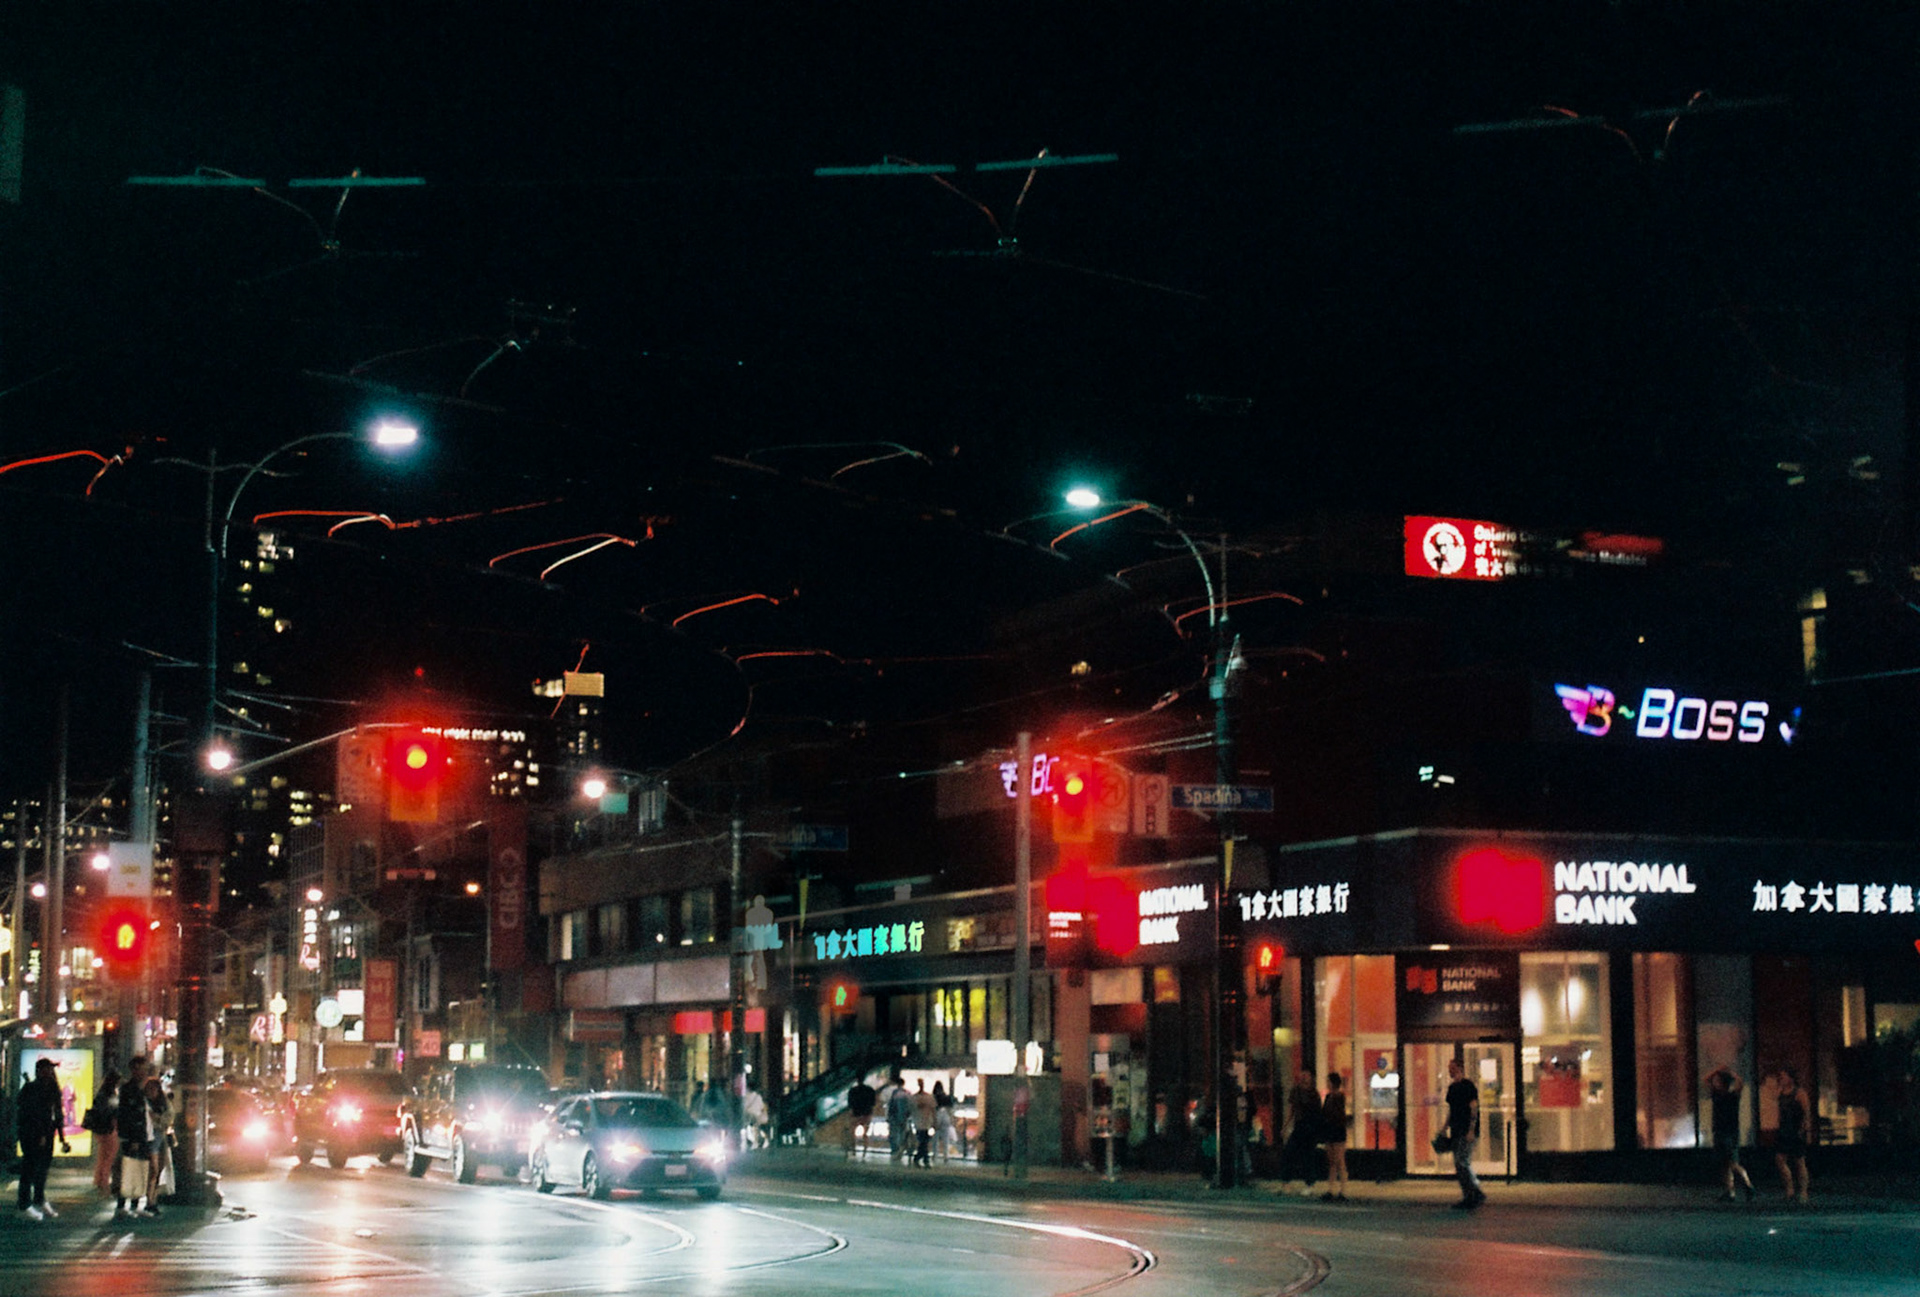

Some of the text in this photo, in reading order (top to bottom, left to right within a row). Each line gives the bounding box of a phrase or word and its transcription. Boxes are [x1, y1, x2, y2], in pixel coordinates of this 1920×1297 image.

[1183, 784, 1242, 808] Spadina
[1554, 861, 1697, 893] NATIONAL
[1139, 884, 1208, 916] NATIONAL
[1555, 894, 1638, 924] BANK
[1752, 879, 1920, 914] 加拿大國家銀
[1139, 916, 1180, 945] BANK
[1442, 967, 1501, 979] NATIONAL
[1442, 980, 1476, 992] BANK
